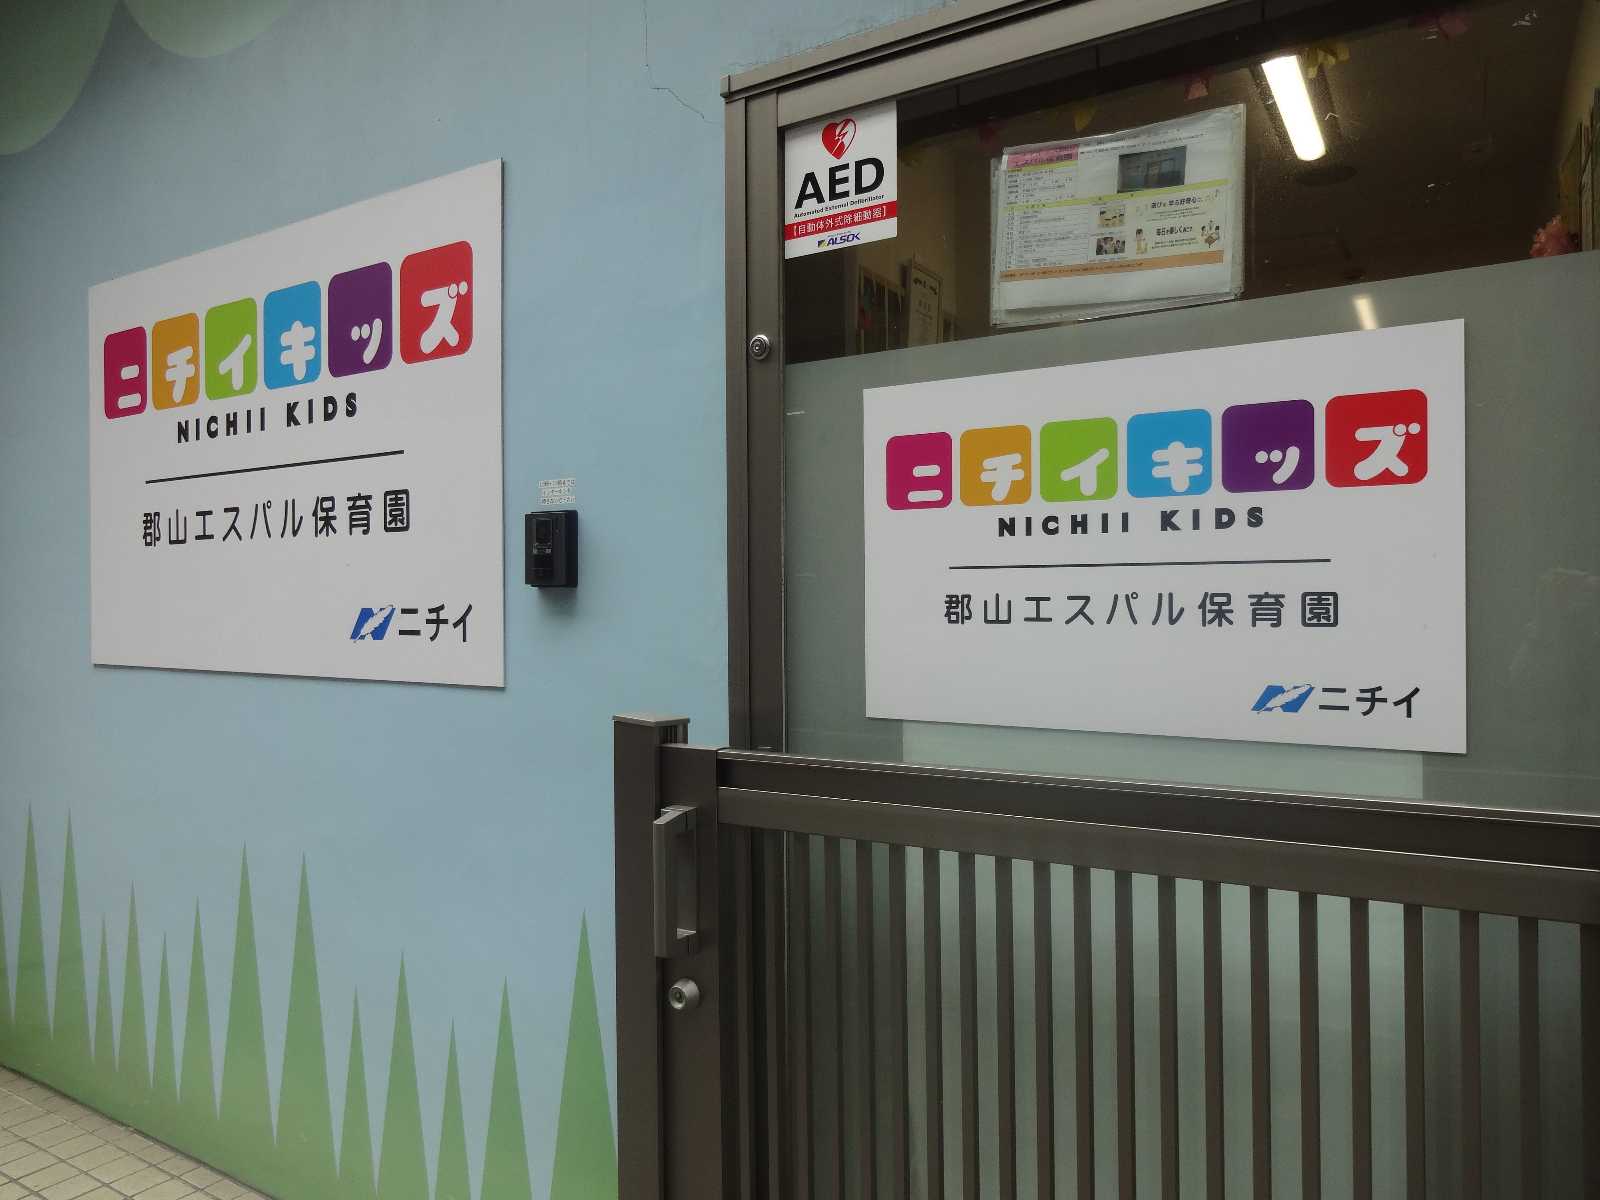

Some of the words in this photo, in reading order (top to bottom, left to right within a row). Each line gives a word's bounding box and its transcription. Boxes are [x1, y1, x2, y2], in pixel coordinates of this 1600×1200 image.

[795, 157, 885, 209] AED
[827, 232, 861, 246] ALSOK
[118, 281, 468, 411] ニチイキッズ
[177, 407, 266, 444] NICHII
[286, 392, 358, 428] KIDS
[907, 422, 1421, 503] ニチイキッズ
[142, 488, 411, 548] 郡山エスパル保育園
[997, 512, 1130, 537] NICHII
[1160, 506, 1265, 532] KIDS
[398, 603, 473, 643] ニチイ
[944, 591, 1339, 629] 郡山エスパル保育園
[1318, 685, 1420, 718] ニチイ
